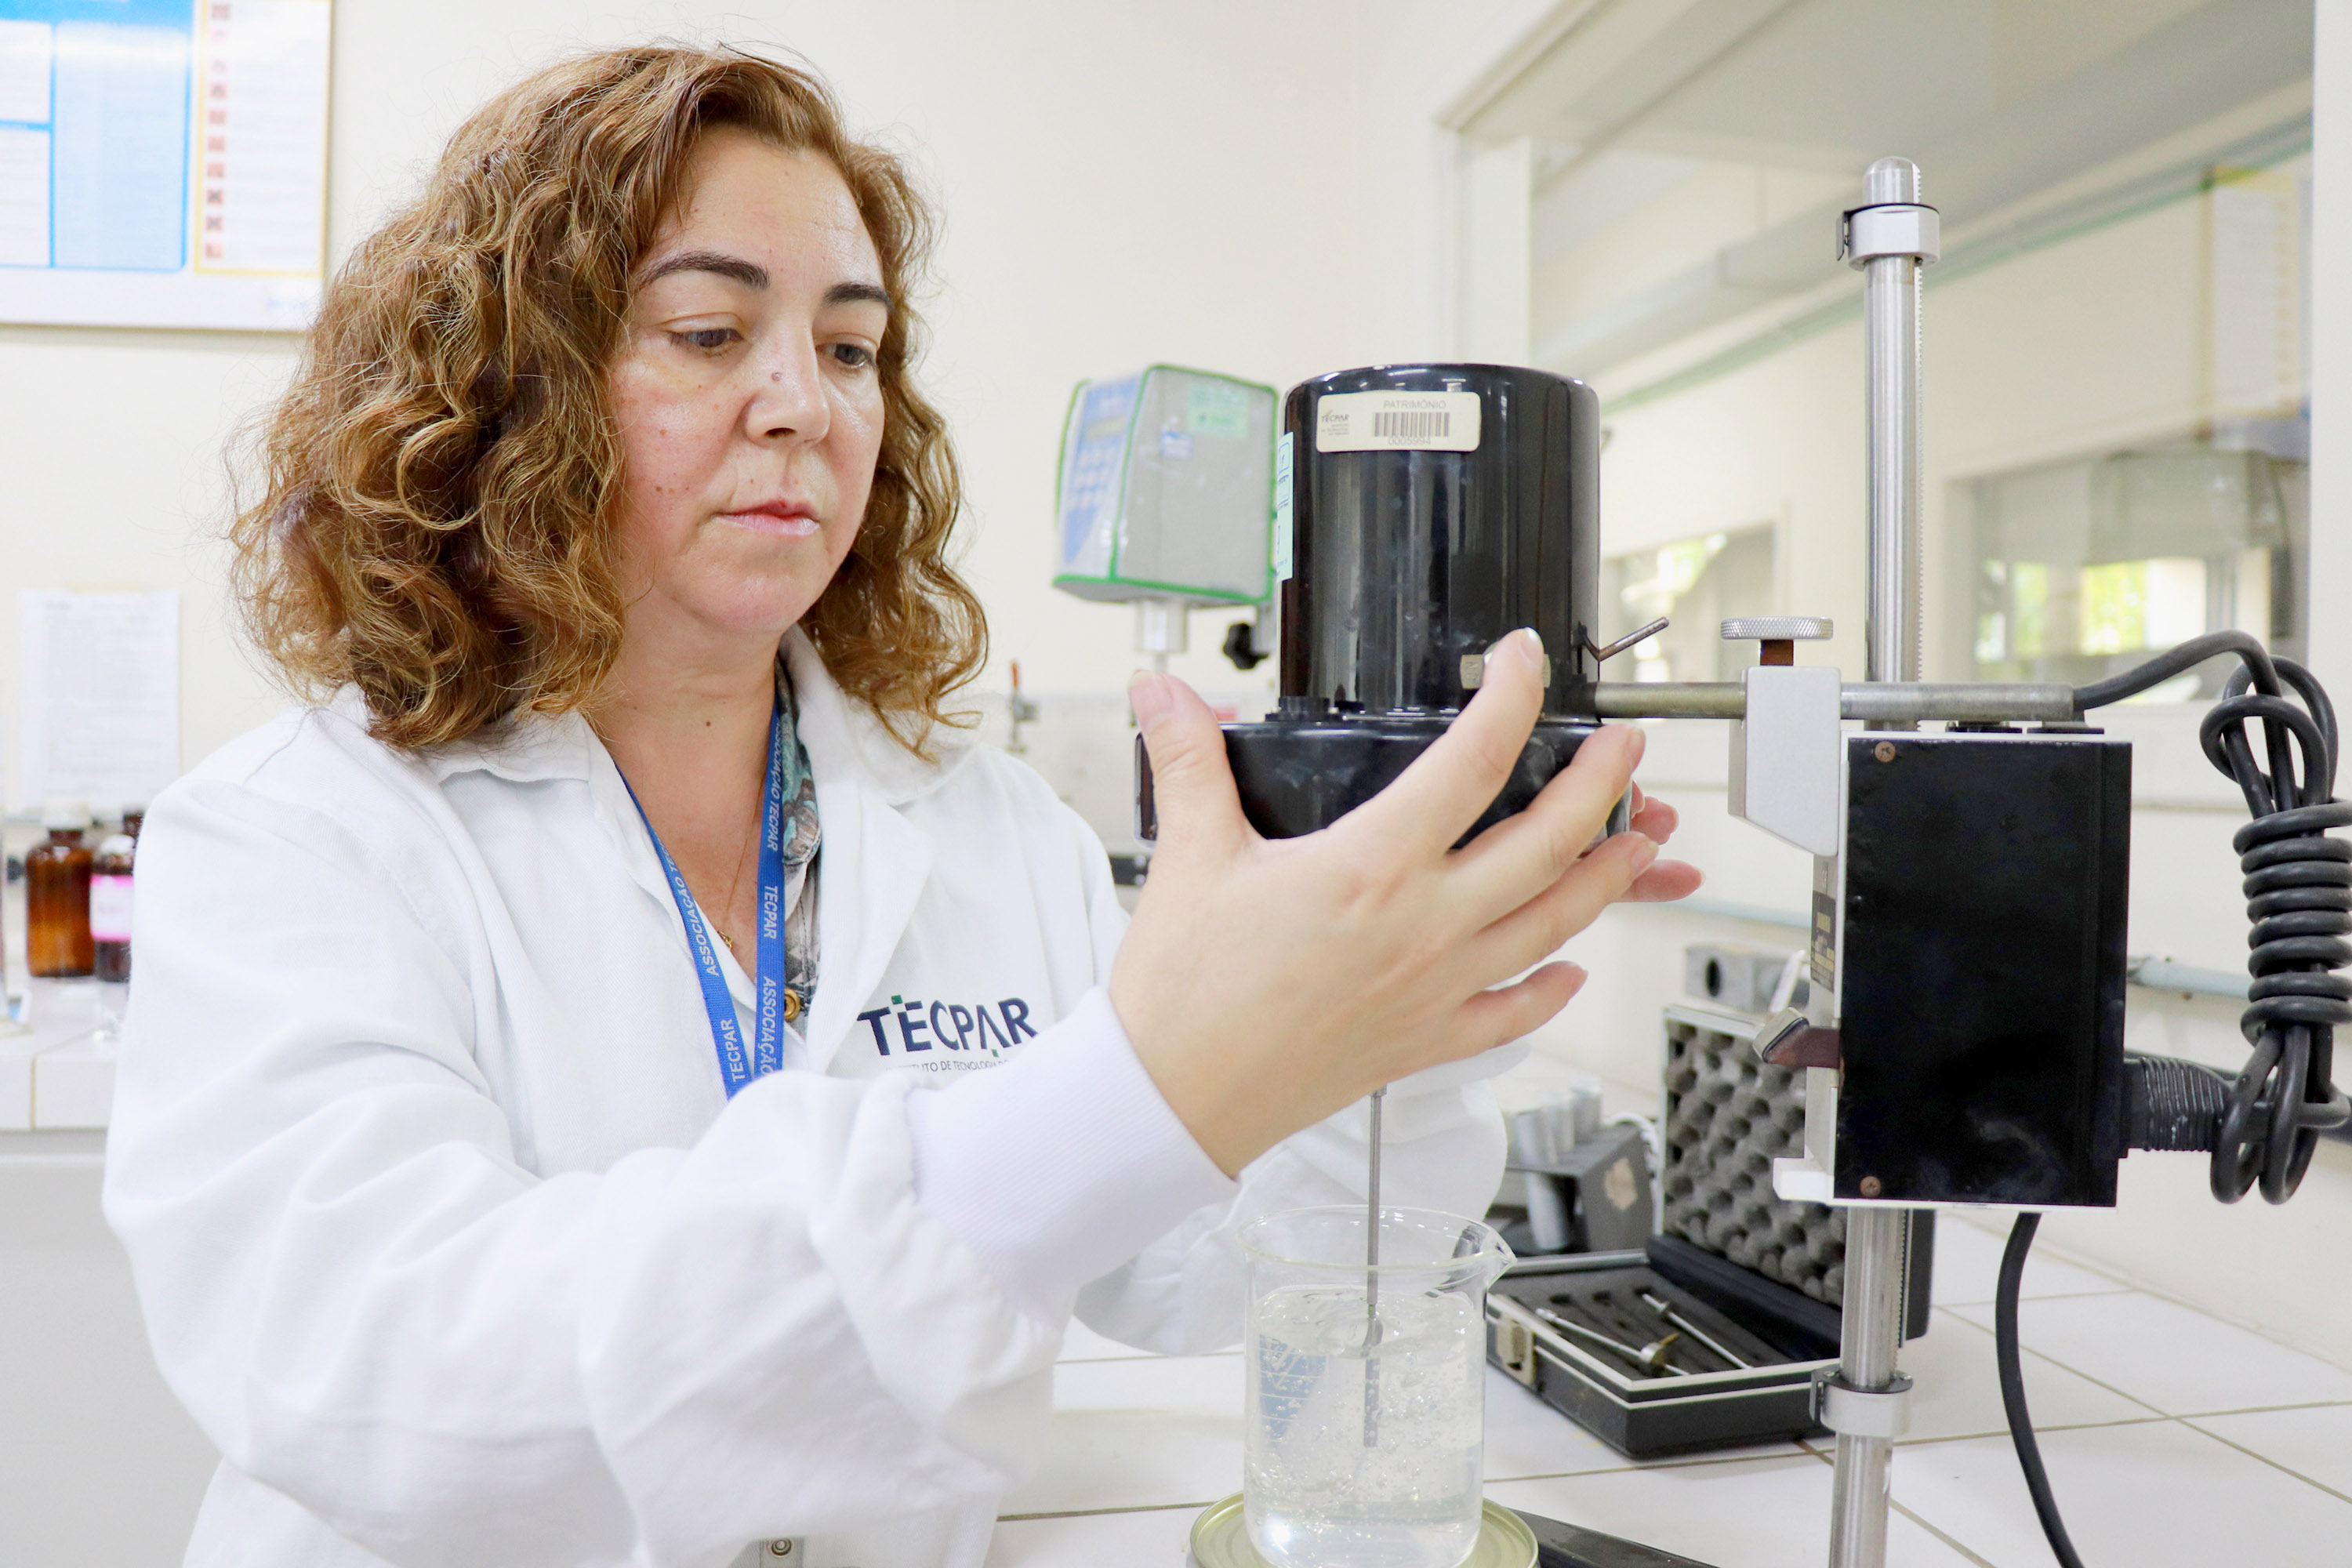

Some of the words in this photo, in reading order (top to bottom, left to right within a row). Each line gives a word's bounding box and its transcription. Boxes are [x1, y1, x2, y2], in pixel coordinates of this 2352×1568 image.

[1383, 399, 1446, 409] PATRIMÔNIO
[767, 801, 779, 851] TECPAR
[764, 885, 778, 939] TECPAR
[720, 1018, 746, 1082] TECPAR
[757, 975, 777, 1076] ASSOCIAÇÃO
[857, 995, 1038, 1057] TECPAR
[940, 1061, 952, 1071] DE
